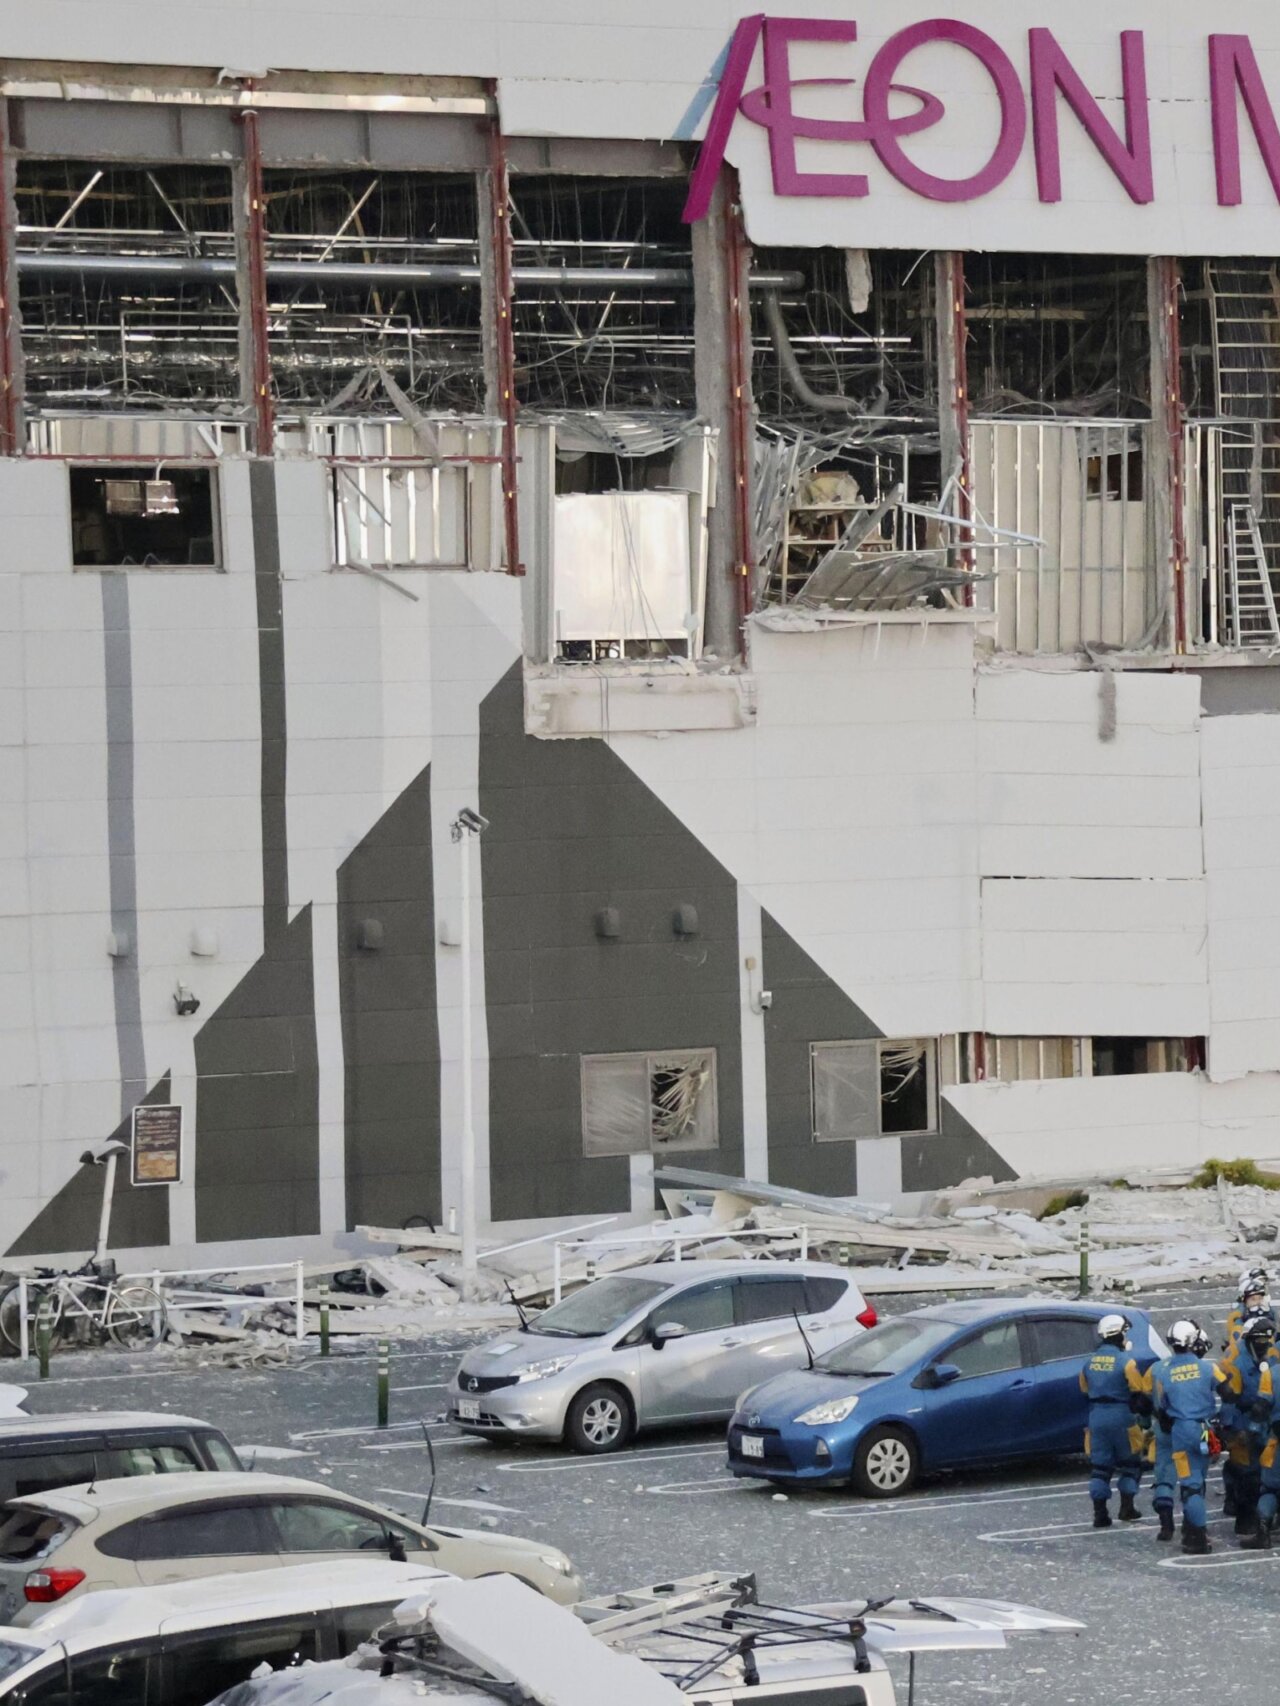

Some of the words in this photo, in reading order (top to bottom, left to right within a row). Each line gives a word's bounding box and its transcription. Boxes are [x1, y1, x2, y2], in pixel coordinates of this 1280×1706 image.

[681, 14, 1154, 224] AEON
[1089, 1363, 1115, 1372] POLICE
[1170, 1370, 1201, 1383] POLICE
